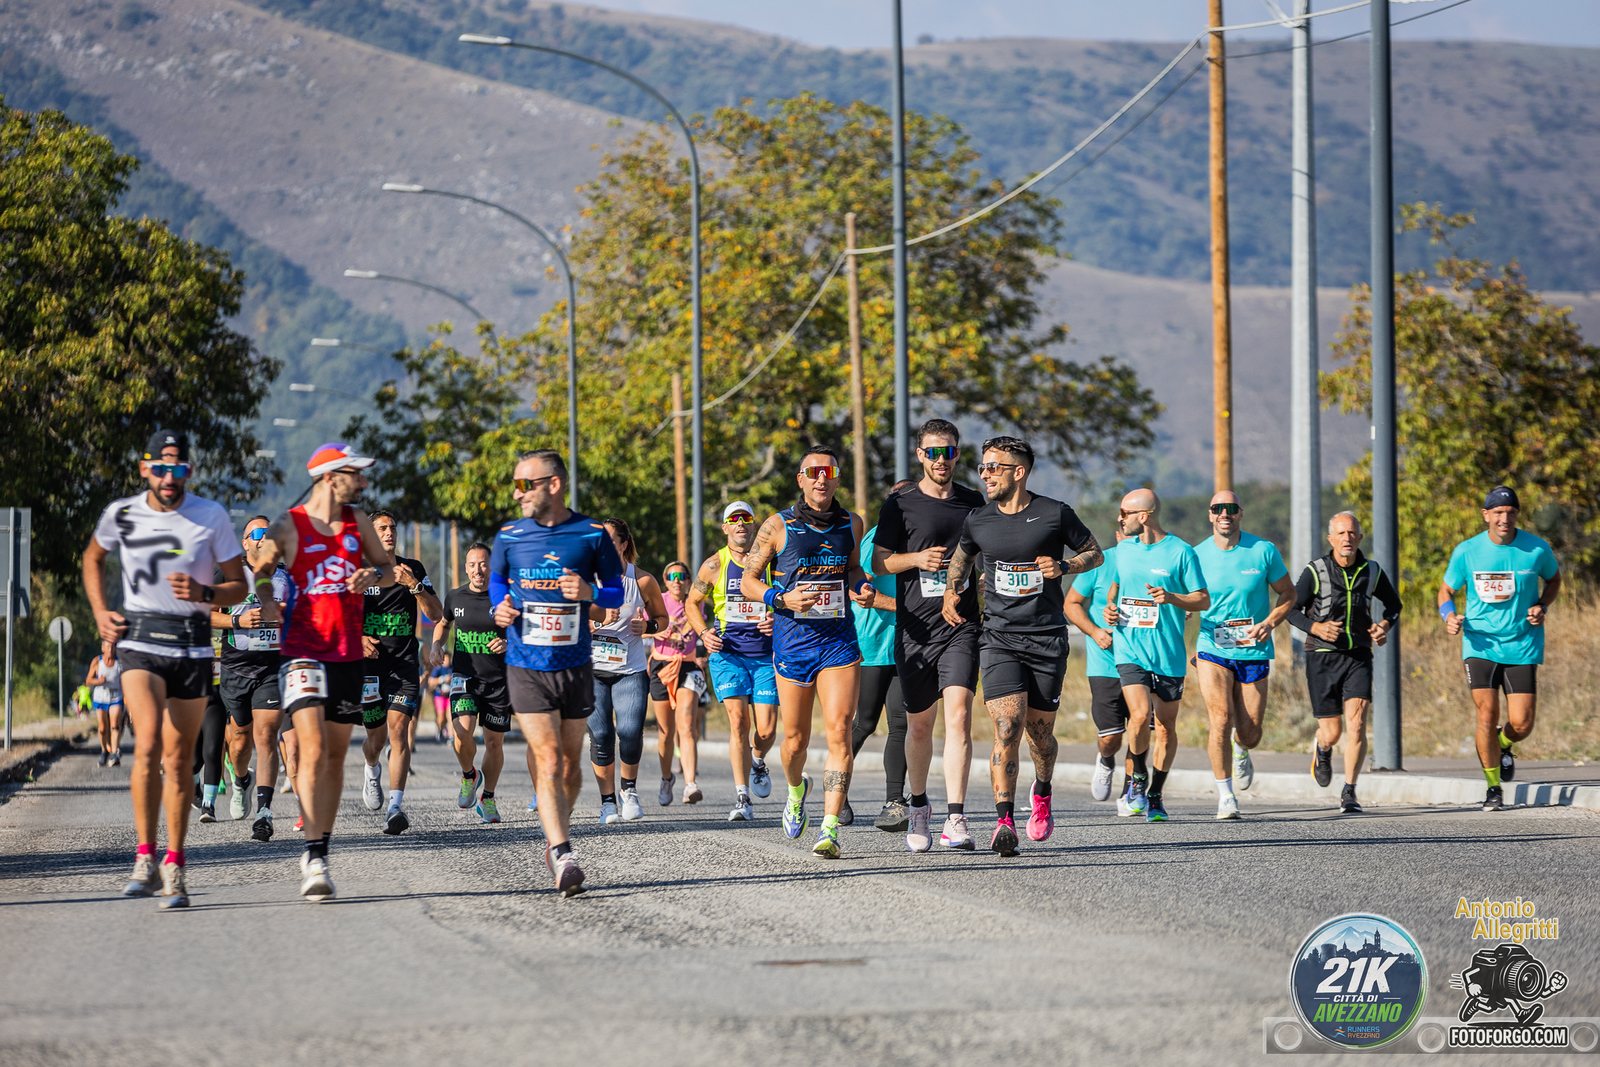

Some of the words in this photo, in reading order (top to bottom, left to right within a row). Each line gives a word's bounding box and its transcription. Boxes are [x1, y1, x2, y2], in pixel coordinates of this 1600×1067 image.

[798, 555, 848, 567] RUNNERS
[519, 568, 576, 579] RUNNE
[1007, 573, 1029, 586] 310
[519, 579, 563, 590] AVEZZA
[1484, 581, 1504, 592] 246
[454, 607, 465, 617] GM
[737, 602, 754, 613] 186
[1129, 606, 1149, 619] 343
[541, 616, 562, 631] 156
[259, 629, 277, 641] 296
[600, 642, 618, 655] 341
